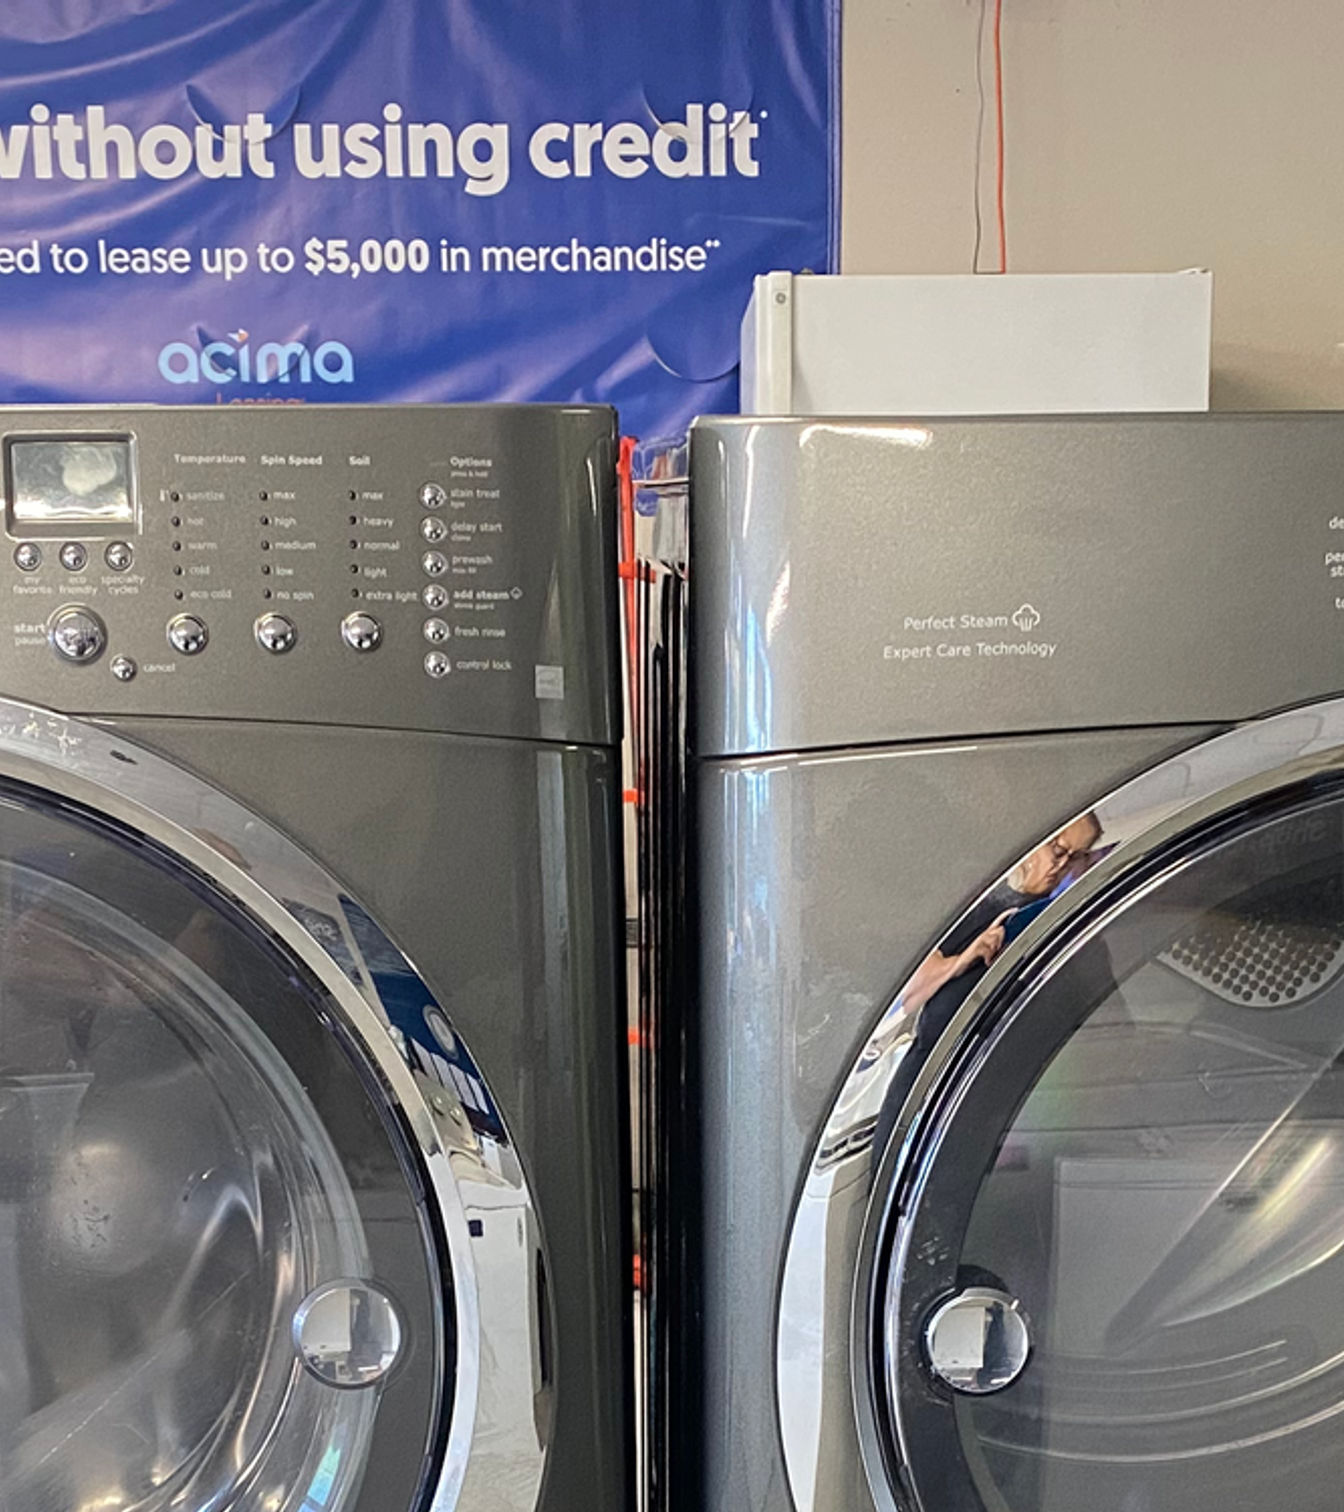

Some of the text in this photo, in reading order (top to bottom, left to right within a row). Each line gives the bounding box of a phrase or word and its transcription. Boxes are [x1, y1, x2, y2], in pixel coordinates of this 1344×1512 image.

[292, 103, 511, 197] using
[50, 246, 90, 274] to
[98, 239, 192, 274] lease
[200, 247, 249, 281] up
[256, 246, 296, 274] to
[304, 237, 430, 280] $5,000
[439, 239, 472, 273] in
[158, 329, 355, 385] acima
[174, 453, 246, 465] Temperature
[260, 455, 323, 467] Spin Speed
[349, 454, 371, 466] Soil
[450, 455, 493, 469] Options
[274, 516, 297, 528] high
[363, 515, 394, 528] heavy
[13, 622, 47, 634] start
[904, 614, 1008, 631] Perfect Steam
[883, 641, 1057, 661] Expert Care Technology
[142, 662, 176, 673] cancel
